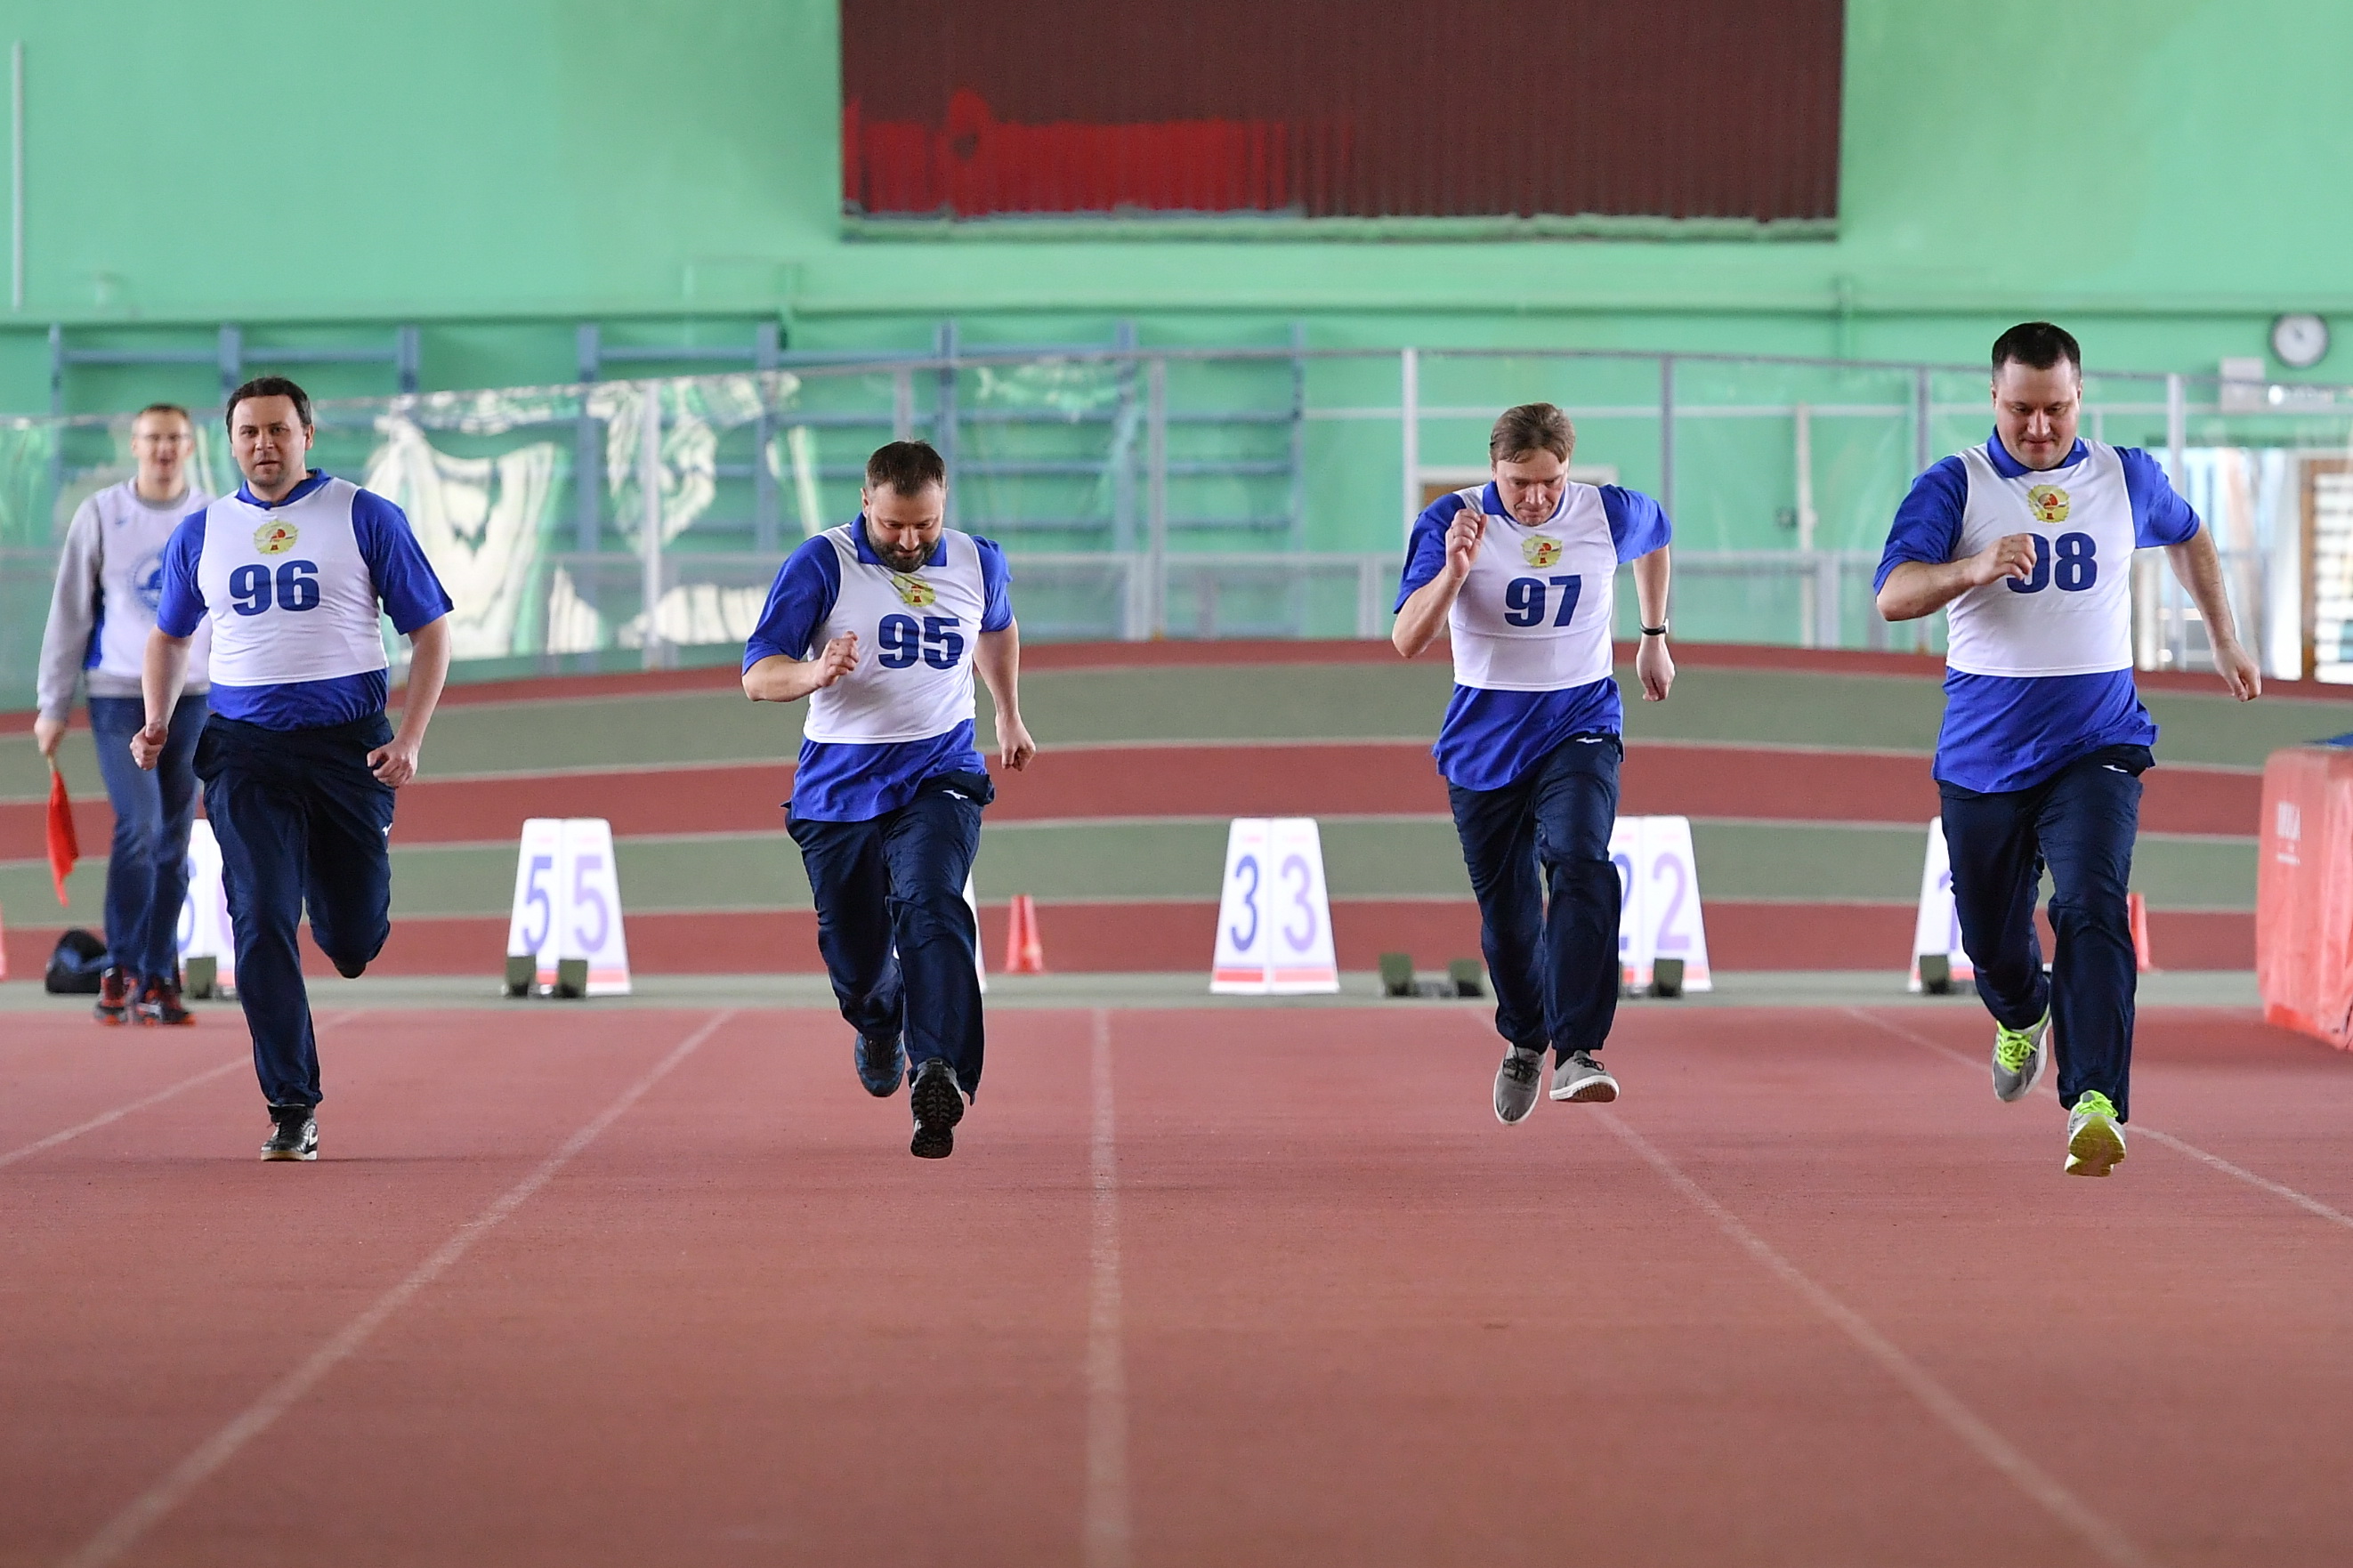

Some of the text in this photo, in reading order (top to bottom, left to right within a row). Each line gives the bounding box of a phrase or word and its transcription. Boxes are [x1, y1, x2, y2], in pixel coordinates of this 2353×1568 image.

[229, 559, 320, 617] 96
[1503, 574, 1582, 628] 97
[2006, 531, 2098, 594] 98
[877, 613, 965, 670] 95
[522, 854, 553, 955] 5
[574, 854, 610, 953] 5
[1231, 854, 1259, 952] 3
[1281, 853, 1317, 952] 3
[1653, 852, 1691, 950] 2
